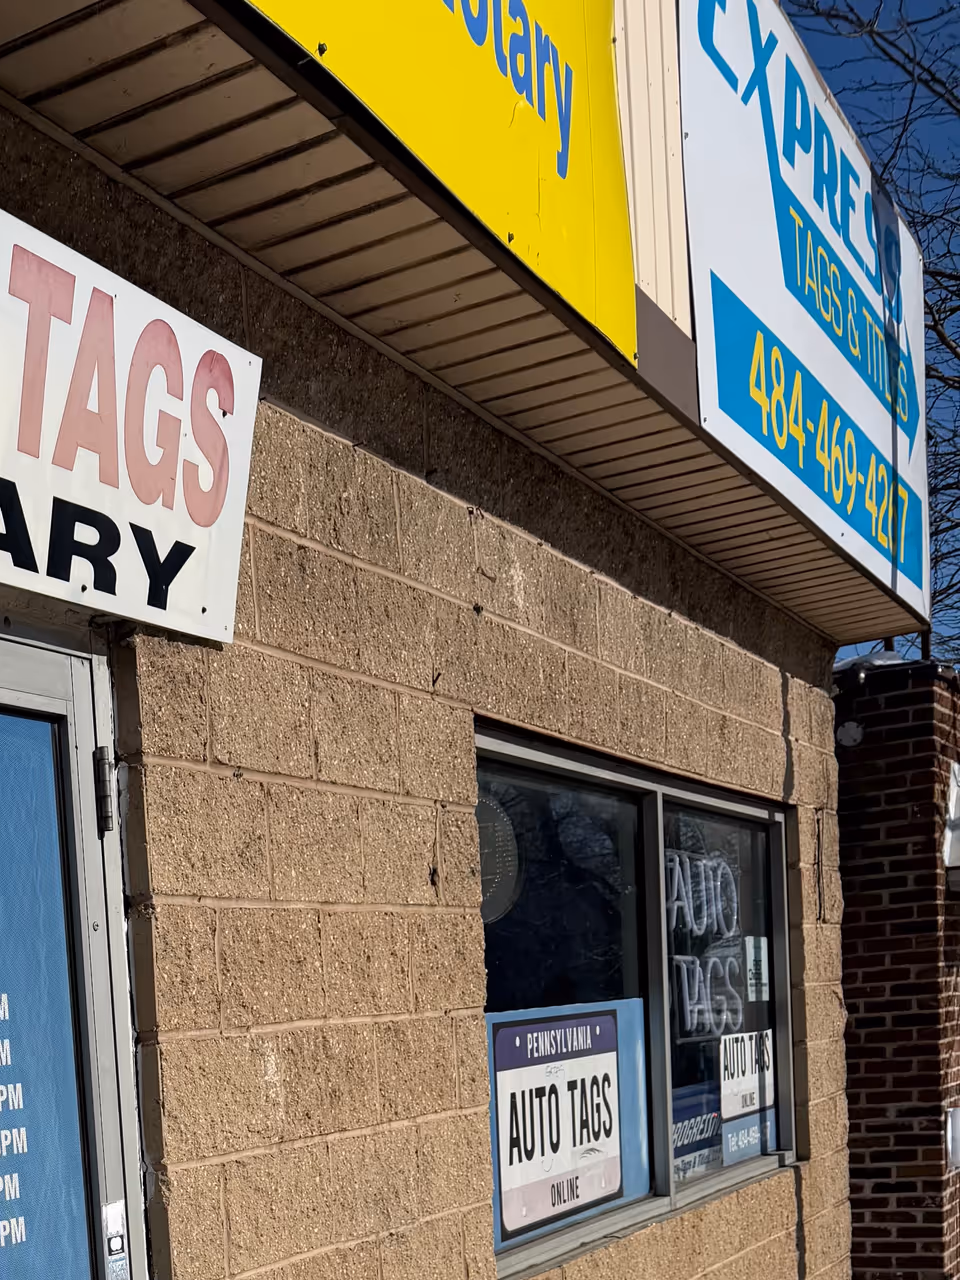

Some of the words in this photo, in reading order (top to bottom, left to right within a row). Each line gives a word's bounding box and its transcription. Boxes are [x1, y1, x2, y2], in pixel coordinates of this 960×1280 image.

[789, 205, 842, 337] TAGS
[848, 287, 861, 361] &
[8, 243, 235, 527] TAGS
[749, 330, 909, 564] 484-469-4267
[527, 1025, 592, 1058] PENNSYLVANIA
[723, 1035, 746, 1081] AUTO
[749, 1032, 770, 1074] TAGS
[509, 1084, 560, 1166] AUTO
[567, 1073, 612, 1147] TAGS
[551, 1176, 579, 1207] ONLINE
